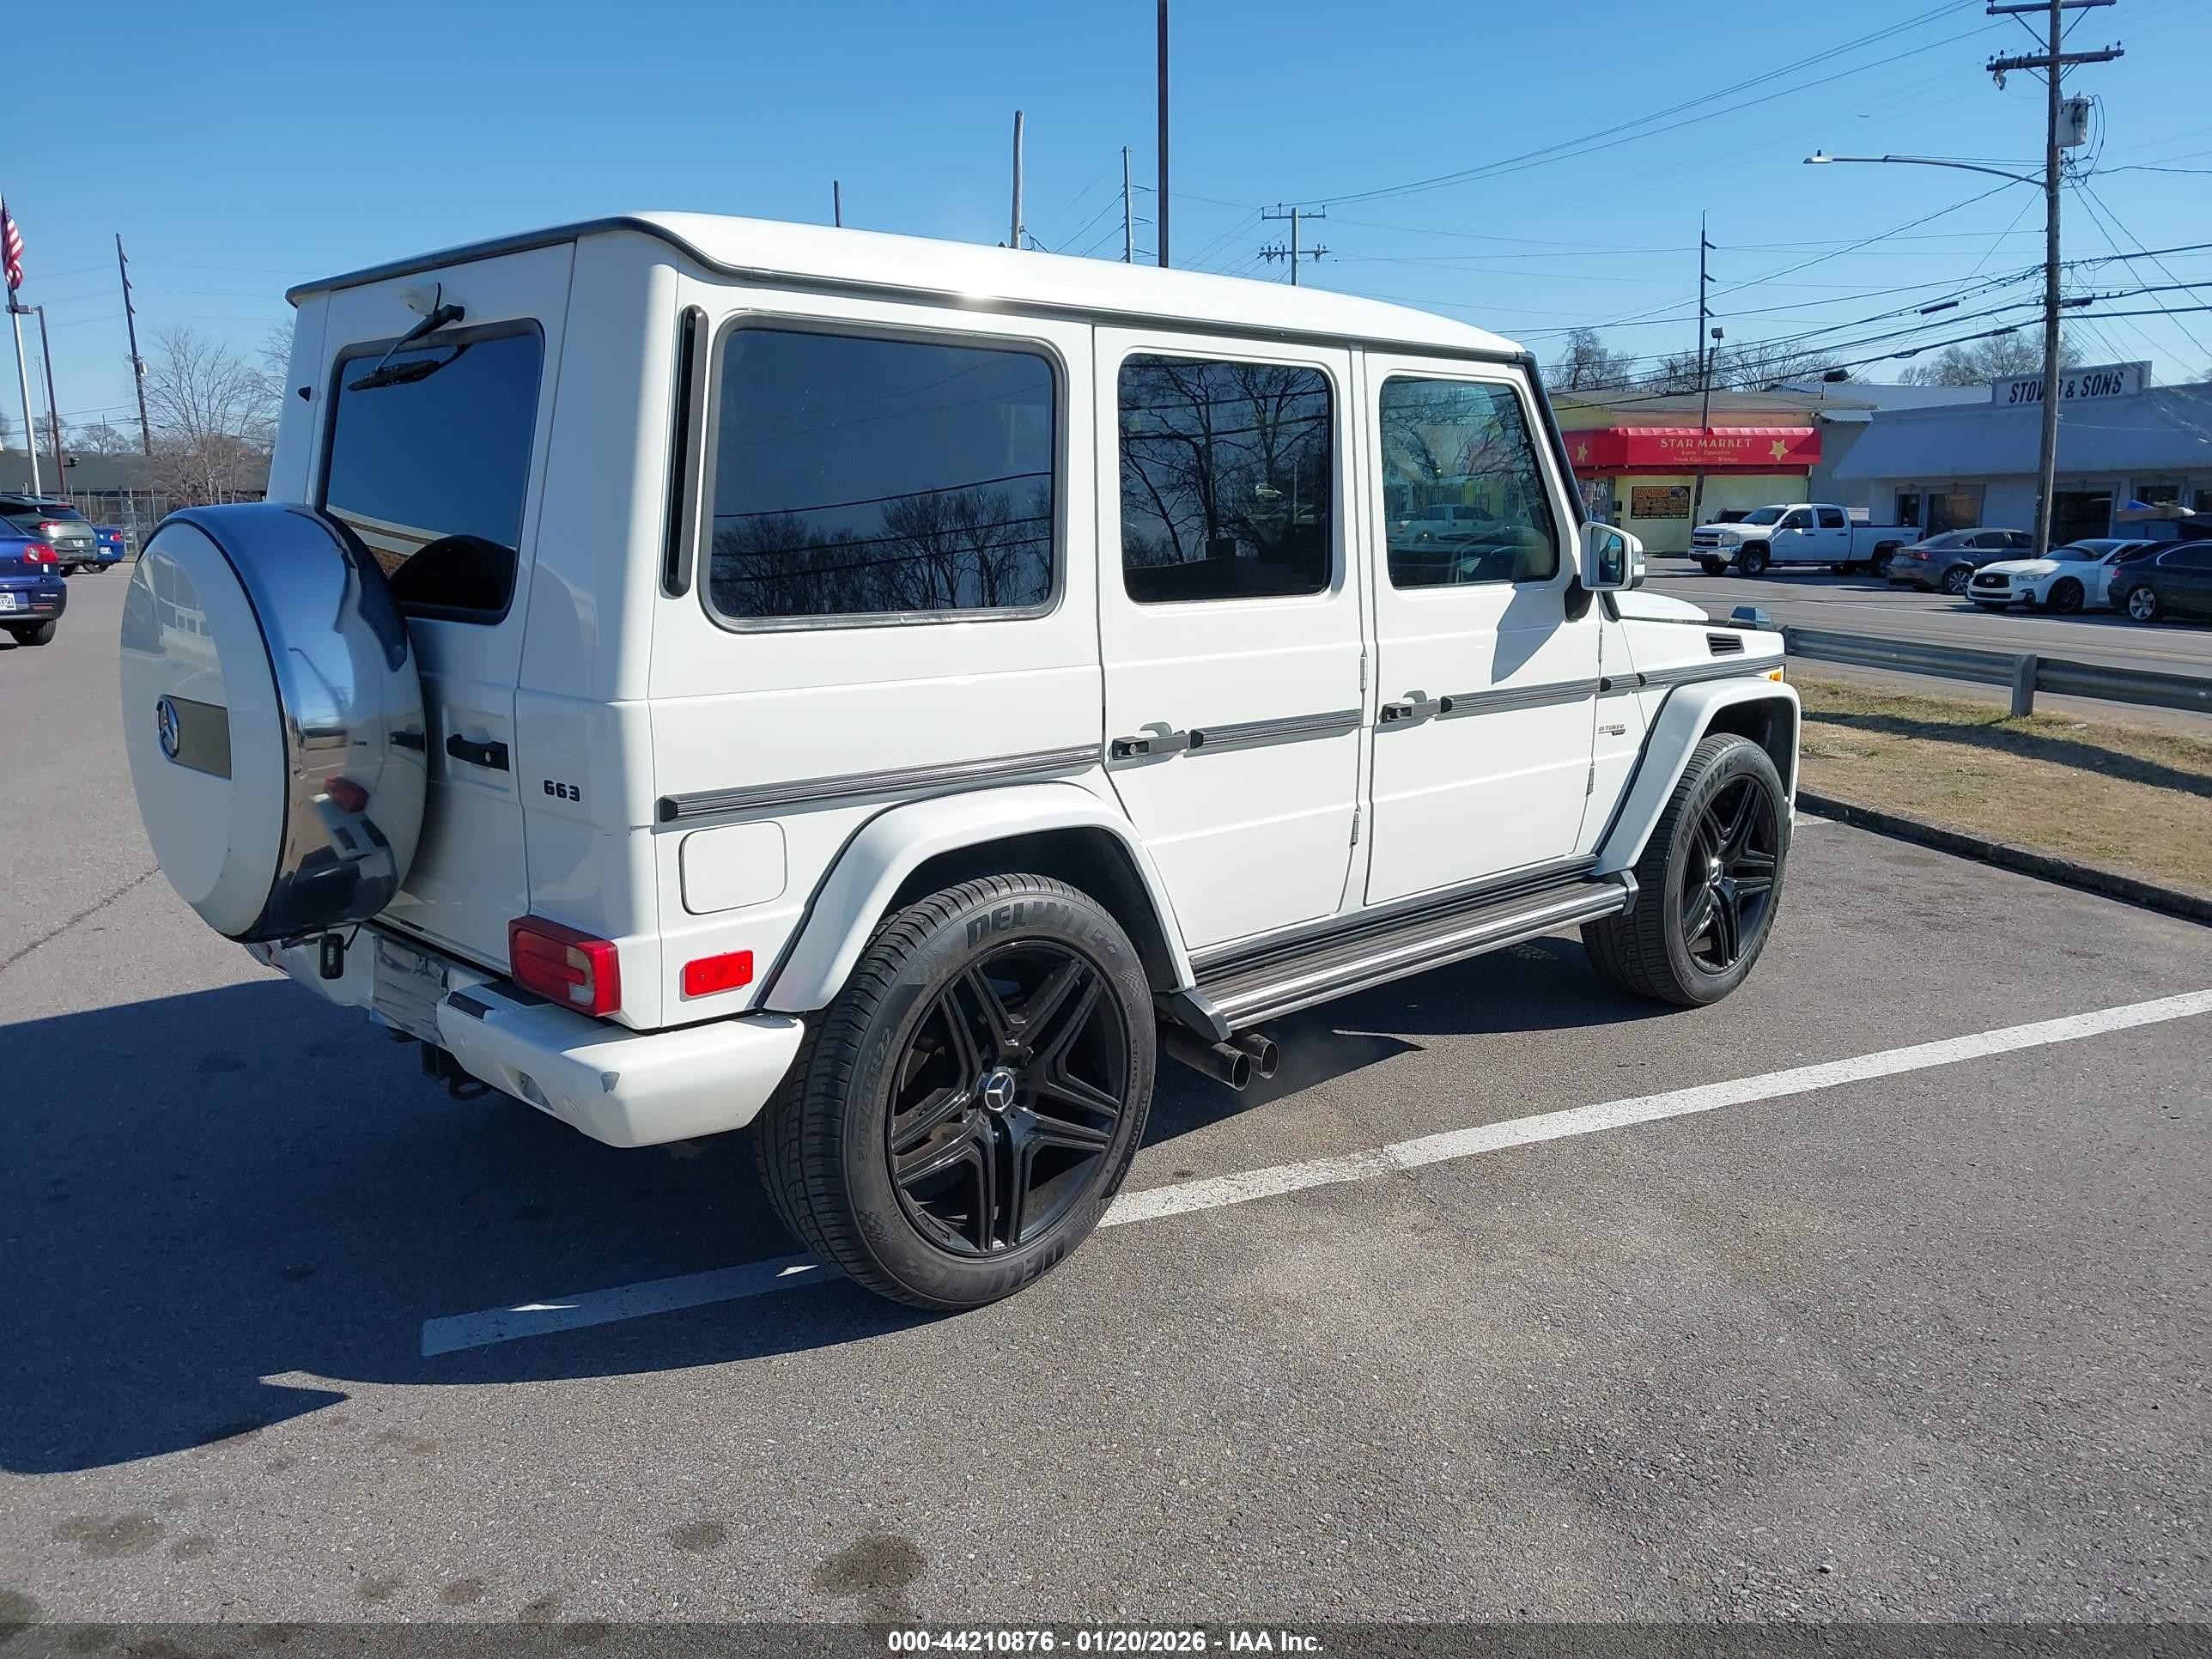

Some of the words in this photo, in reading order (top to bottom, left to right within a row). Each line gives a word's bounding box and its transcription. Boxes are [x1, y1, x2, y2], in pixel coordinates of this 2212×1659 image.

[2065, 380, 2075, 398] &
[2081, 372, 2124, 398] SONS
[1661, 438, 1693, 447] STAR
[1698, 438, 1752, 447] MARKET
[544, 779, 580, 802] G63
